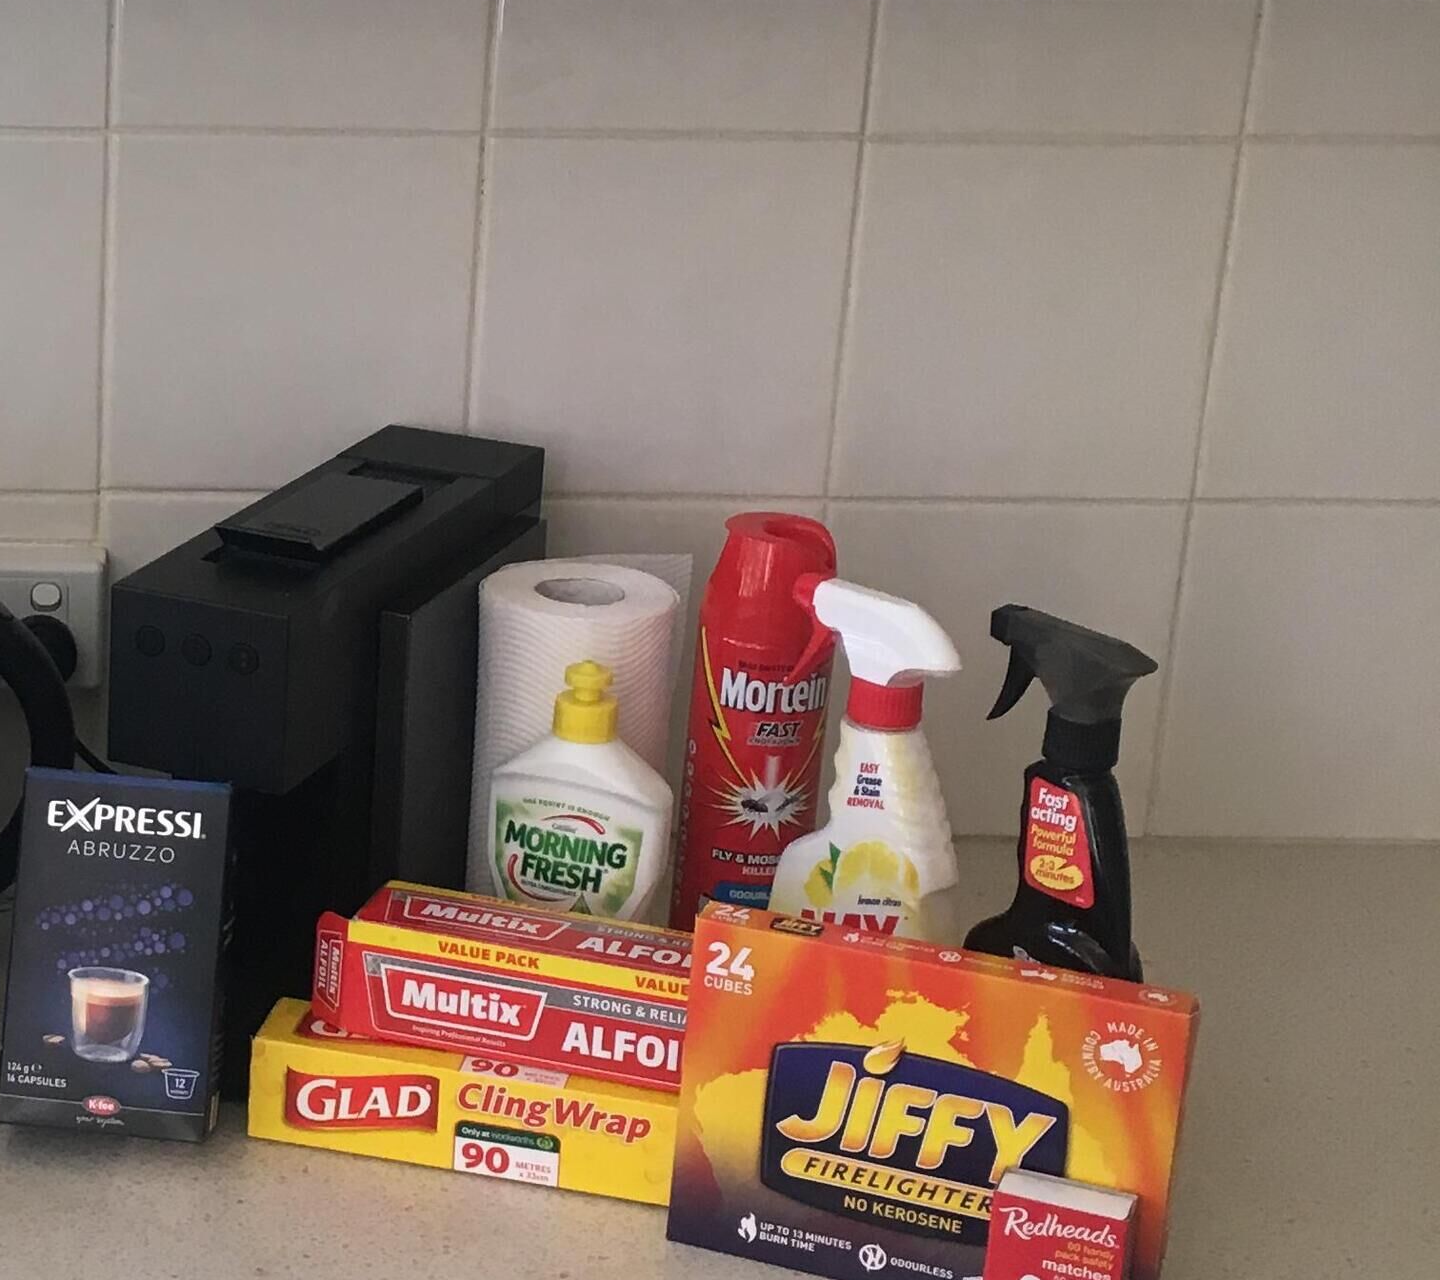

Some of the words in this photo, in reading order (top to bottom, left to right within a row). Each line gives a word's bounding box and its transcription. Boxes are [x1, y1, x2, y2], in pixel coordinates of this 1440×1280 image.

[720, 666, 827, 714] Mortein
[757, 722, 801, 738] FAST
[856, 774, 883, 786] Grease
[860, 762, 880, 774] EASY
[846, 797, 885, 810] REMOVAL
[1038, 787, 1070, 810] Fast
[47, 797, 203, 840] EXPRESSI
[1031, 807, 1077, 832] acting
[505, 819, 628, 870] MORNING
[1031, 823, 1077, 845] Powerful
[67, 839, 176, 864] ABRUZZO
[712, 848, 733, 861] FLY
[735, 854, 745, 864] &
[1032, 837, 1074, 857] formula
[520, 851, 604, 894] FRESH
[715, 904, 752, 920] 24
[857, 895, 881, 906] lemon
[420, 903, 542, 936] Multix
[596, 925, 656, 941] STRONG
[671, 939, 690, 948] RE
[318, 938, 329, 990] ALFOIL
[438, 940, 491, 961] VALUE
[495, 950, 540, 970] PACK
[577, 936, 693, 969] ALFOI
[706, 941, 756, 982] 24
[635, 975, 690, 996] VALUE
[703, 974, 753, 996] CUBES
[401, 978, 522, 1028] Multix
[573, 993, 632, 1016] STRONG
[635, 1005, 647, 1018] &
[561, 1020, 680, 1073] ALFOI
[1106, 1021, 1145, 1040] MADE
[1143, 1036, 1160, 1052] IN
[7, 1061, 22, 1072] 124
[23, 1065, 29, 1074] g
[471, 1058, 520, 1078] 90
[1103, 1058, 1162, 1093] AUSTRALIA
[17, 1074, 67, 1089] CAPSULES
[175, 1077, 186, 1089] 12
[296, 1078, 432, 1122] GLAD
[461, 1126, 481, 1138] Only
[462, 1142, 510, 1174] 90
[515, 1161, 552, 1174] METRES
[803, 1156, 994, 1214] FIRELIGHTER
[844, 1194, 868, 1213] NO
[872, 1202, 963, 1235] KEROSENE
[760, 1221, 775, 1233] UP
[777, 1225, 790, 1236] TO
[793, 1228, 804, 1239] 13
[805, 1230, 853, 1251] MINUTES
[999, 1206, 1116, 1249] Redheads
[759, 1231, 789, 1246] BURN
[791, 1238, 816, 1253] TIME
[890, 1257, 954, 1280] ODOURLESS
